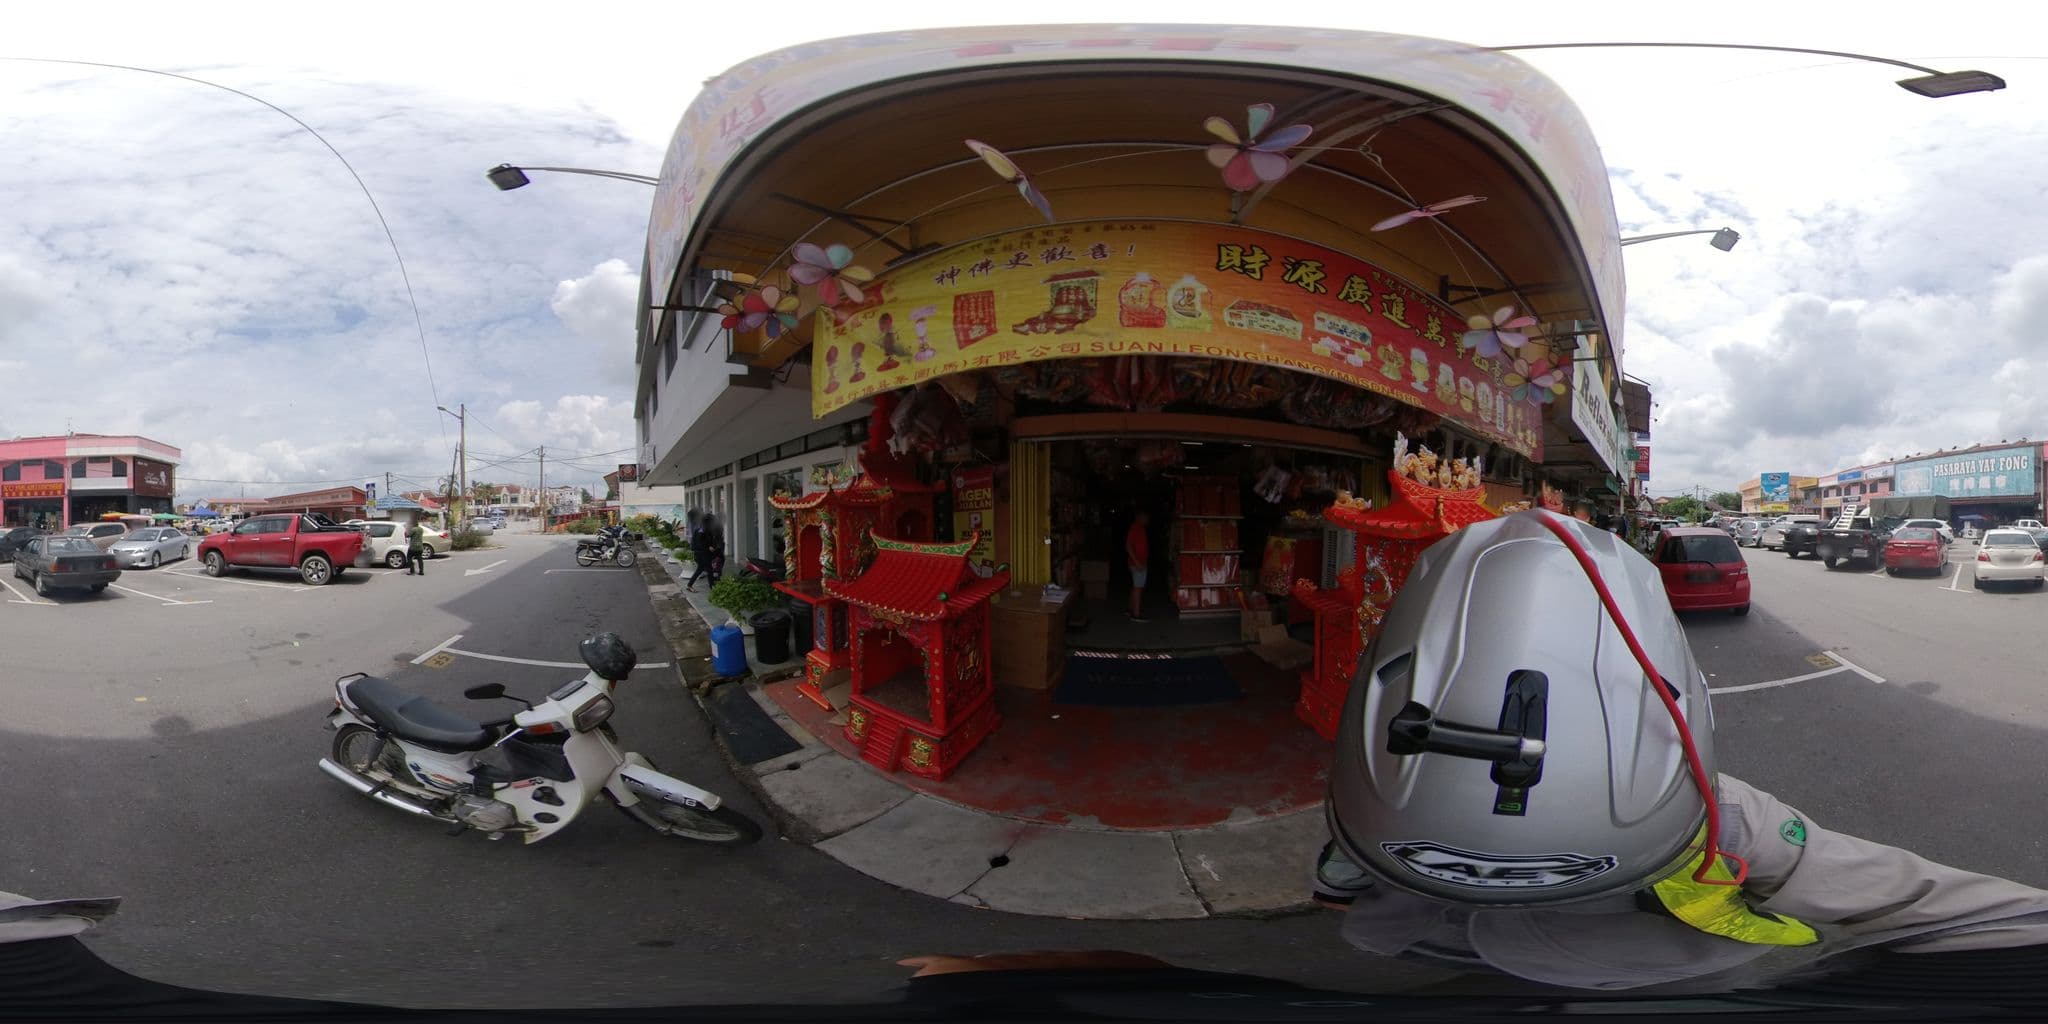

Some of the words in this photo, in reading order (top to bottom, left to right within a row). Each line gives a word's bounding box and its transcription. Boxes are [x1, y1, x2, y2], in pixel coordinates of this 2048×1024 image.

[1090, 341, 1163, 353] SUAN
[1172, 344, 1260, 361] LEONG
[1265, 354, 1328, 375] HANG
[1934, 460, 1976, 477] PASARAYA
[1978, 458, 1996, 473] YAT
[1999, 455, 2029, 471] FONG
[960, 487, 992, 501] AGEN
